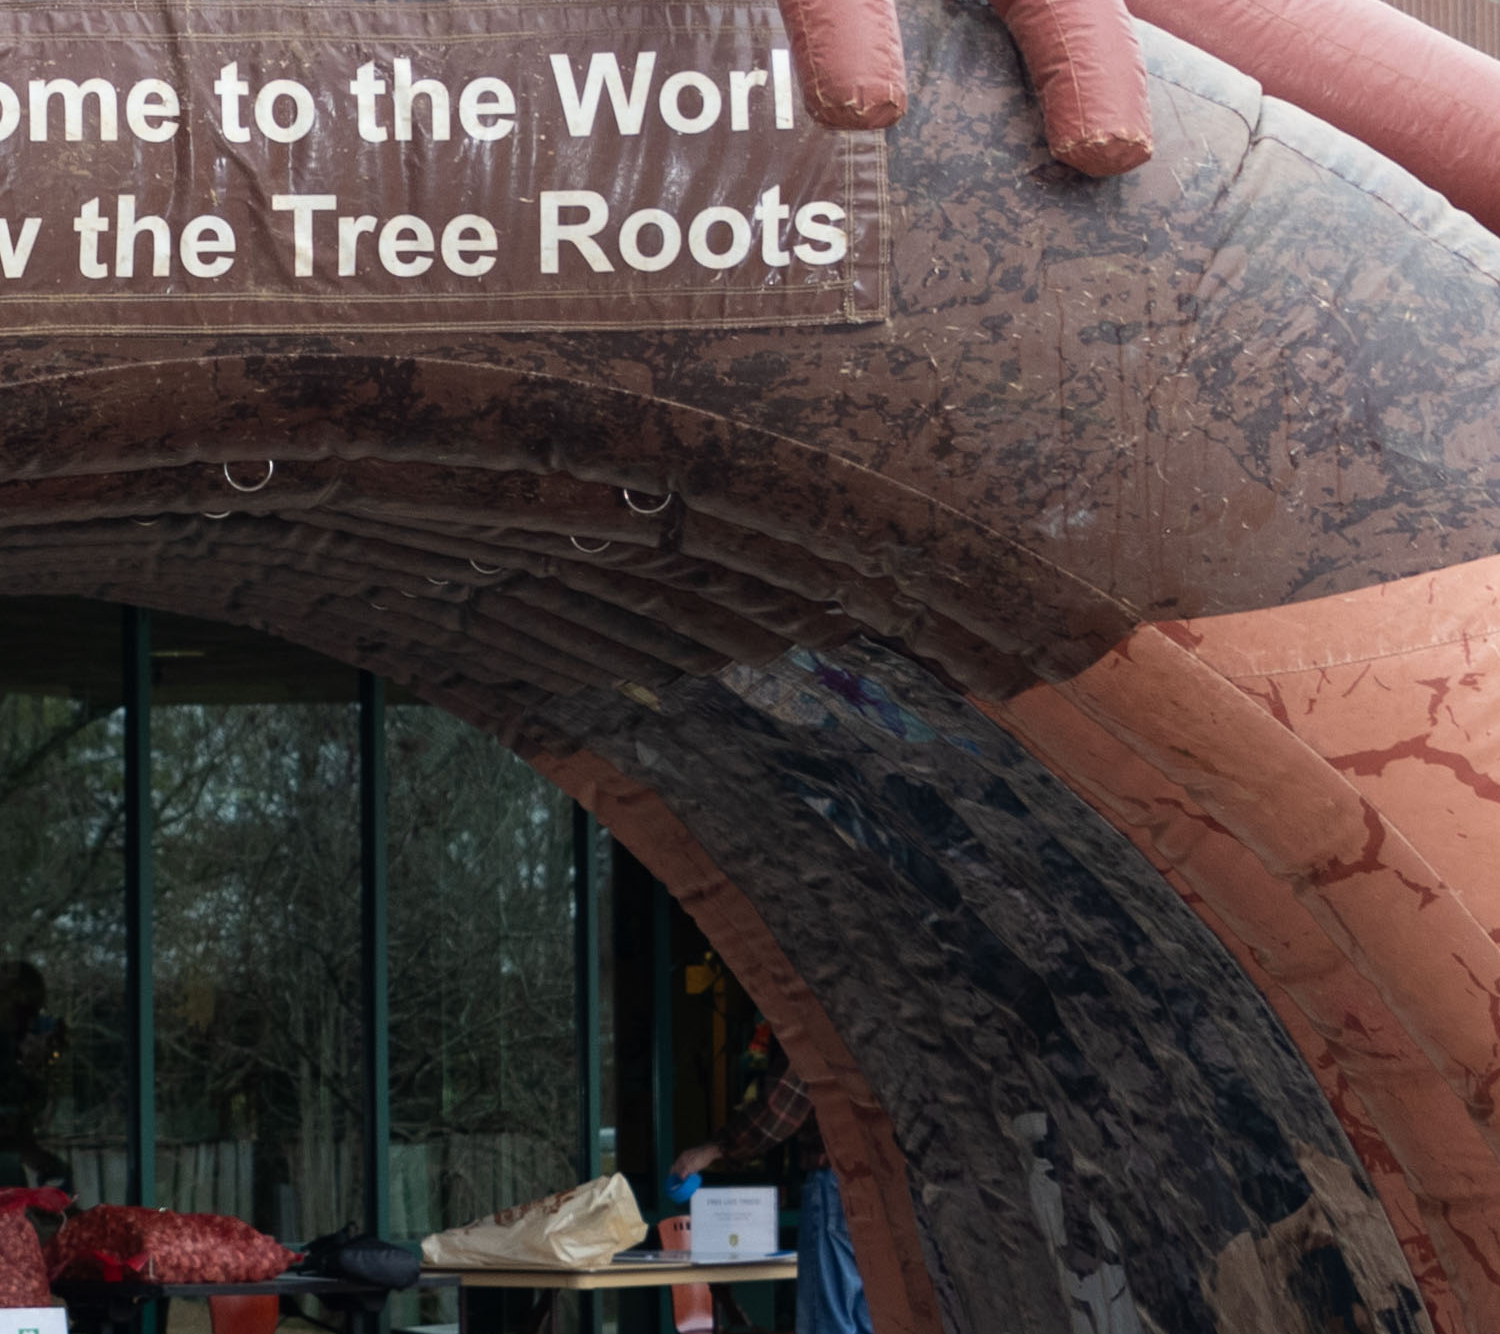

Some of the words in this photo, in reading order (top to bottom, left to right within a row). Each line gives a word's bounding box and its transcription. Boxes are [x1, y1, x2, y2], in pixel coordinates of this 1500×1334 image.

[213, 60, 321, 145] to
[349, 54, 519, 148] the
[549, 46, 795, 139] Worl
[73, 194, 237, 279] the
[271, 193, 498, 278] Tree
[540, 184, 848, 274] Roots
